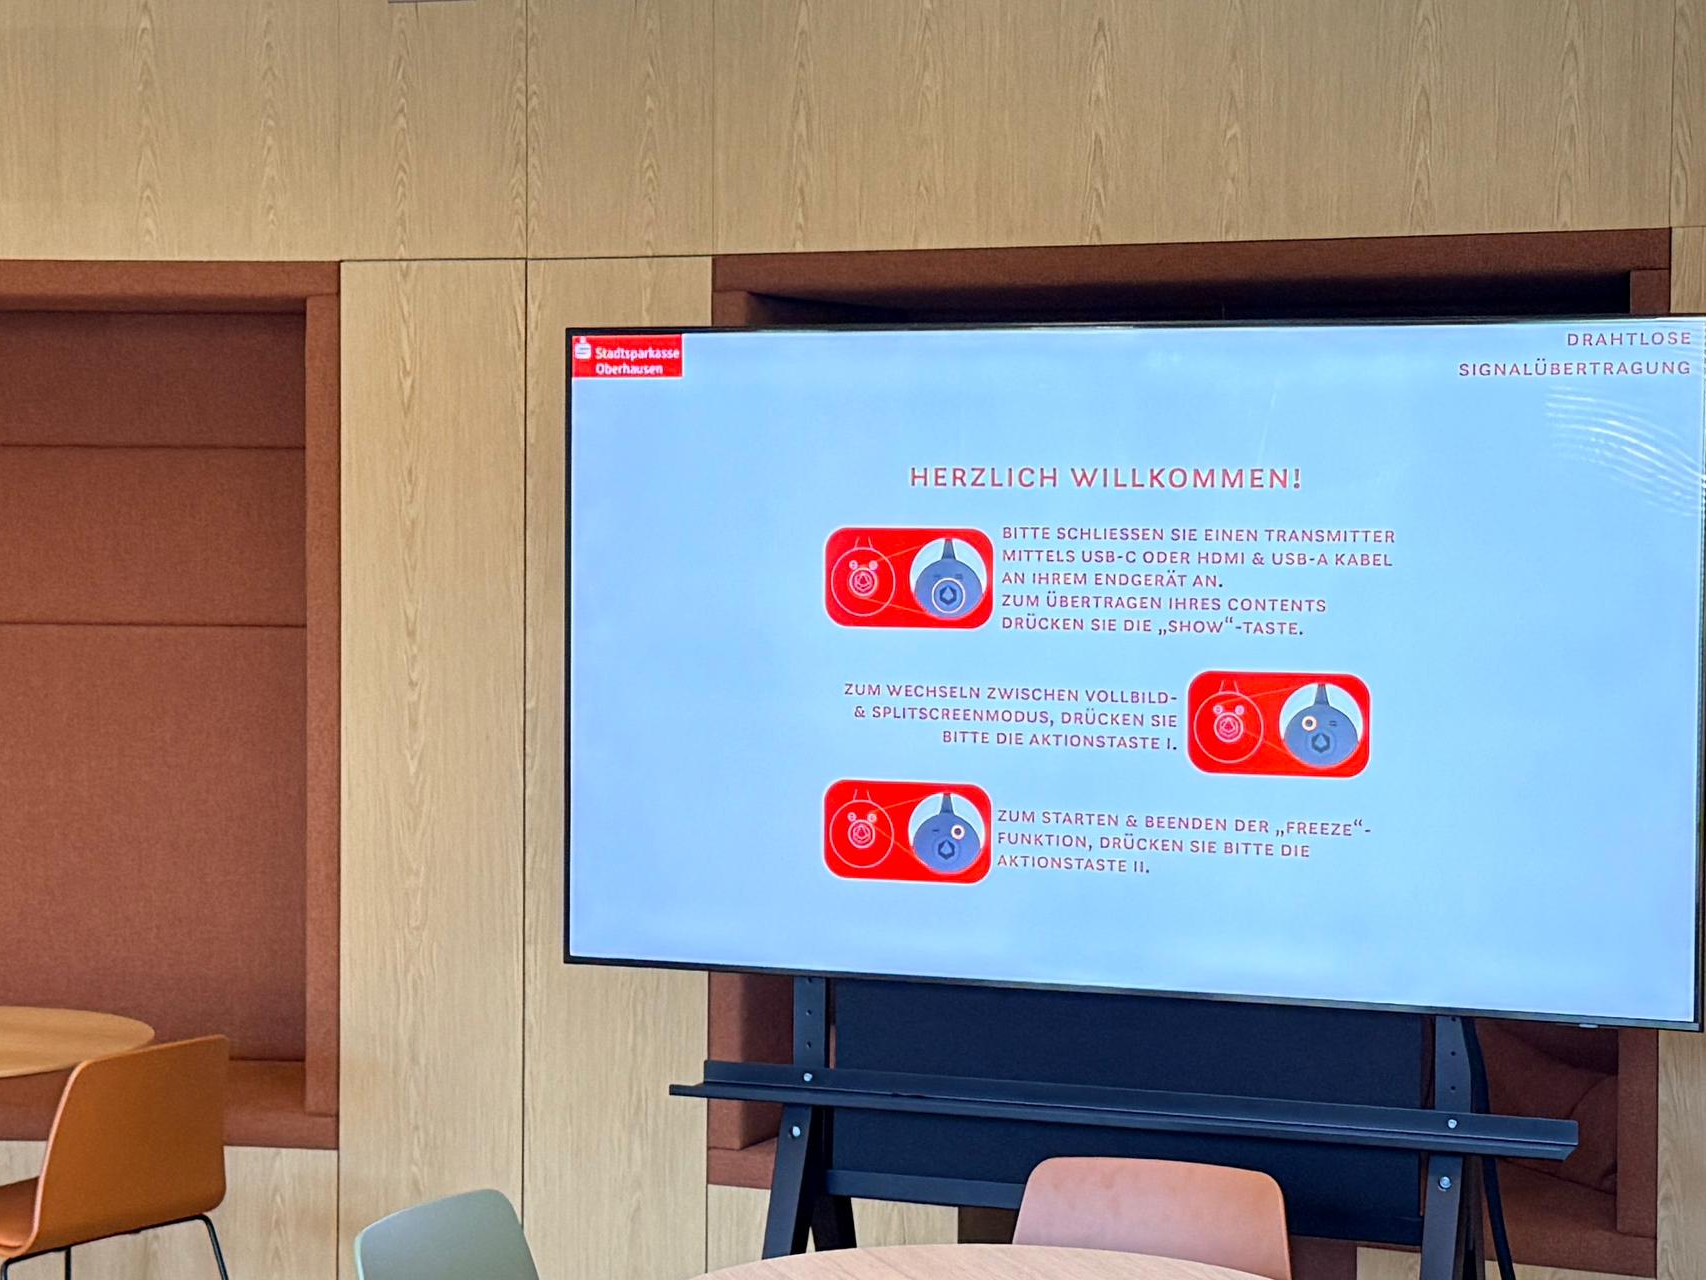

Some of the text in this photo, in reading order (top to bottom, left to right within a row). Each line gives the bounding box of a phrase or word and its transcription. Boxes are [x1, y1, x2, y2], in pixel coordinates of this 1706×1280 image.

[1567, 331, 1691, 347] DRAHTLOSE
[595, 347, 680, 361] Stadtsparkasse
[595, 362, 664, 375] Oberhausen
[1458, 357, 1690, 377] SIGNALÜBERTRAGUNG
[910, 466, 1301, 490] HERZLICH WILLKOMMEN!
[1002, 526, 1395, 544] BITTE SCHLIESSEN SIE EINEN TRANSMITTER
[1002, 549, 1393, 567] MITTELS USB-C ODER HDMI & USB-A KABEL
[1001, 569, 1224, 588] AN IHREM ENDGERÄT AN.
[1001, 589, 1326, 613] ZUM ÜBERTRAGEN IHRES CONTENTS
[1001, 612, 1084, 631] DRÜCKEN
[1090, 617, 1117, 632] SIE
[1123, 619, 1152, 633] DIE
[844, 682, 1178, 705] ZUM WECHSELN ZWISCHEN VOLLBILD-
[853, 705, 1178, 728] & SPLITSCREENMODUS, DRÜCKEN SIE
[942, 730, 990, 744] BITTE
[996, 732, 1024, 746] DIE
[1028, 733, 1161, 750] AKTIONSTASTE
[997, 809, 1036, 824] ZUM
[1041, 810, 1119, 827] STARTEN
[1125, 814, 1138, 828] &
[1144, 815, 1227, 832] BEENDEN
[1234, 818, 1269, 834] DER
[997, 831, 1310, 858] FUNKTION, DRÜCKEN SIE BITTE DIE
[996, 854, 1127, 873] AKTIONSTASTE
